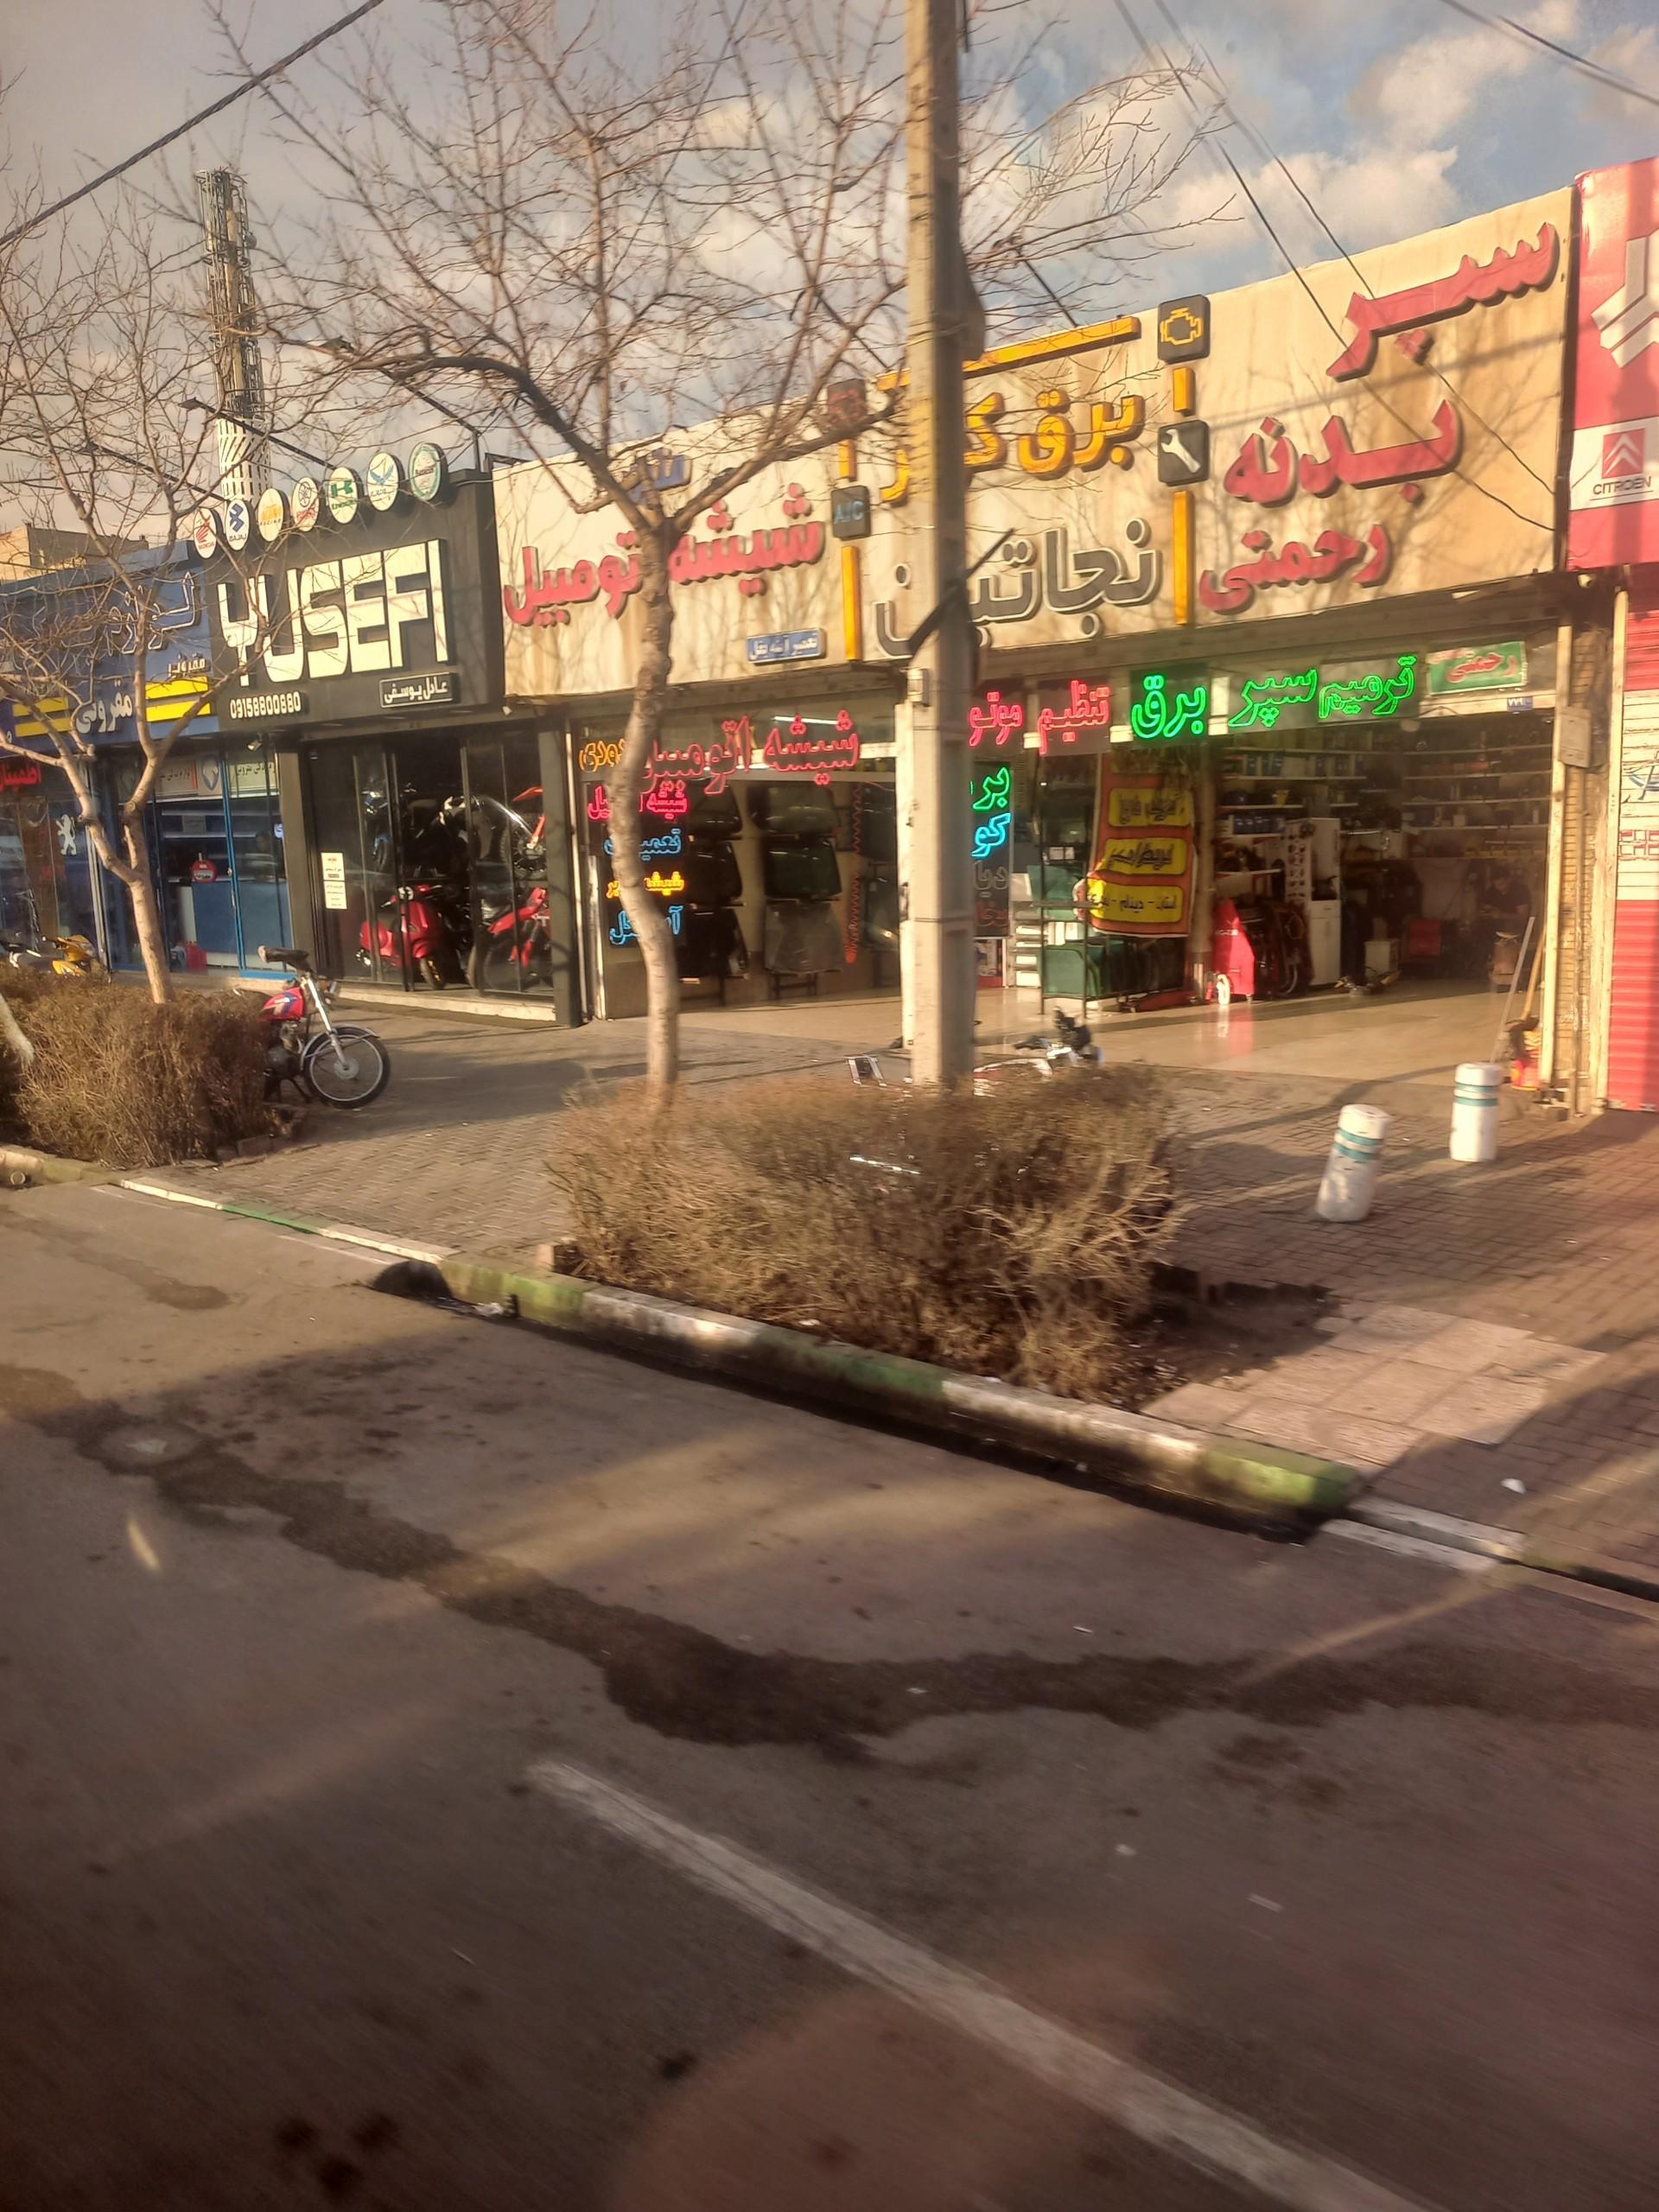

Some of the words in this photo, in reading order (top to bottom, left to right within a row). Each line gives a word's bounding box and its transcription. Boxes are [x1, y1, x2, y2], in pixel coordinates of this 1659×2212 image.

[1326, 221, 1558, 380] سپر
[880, 391, 1006, 503] کر
[1019, 389, 1144, 475] برق
[1224, 399, 1462, 506] بدنه
[503, 530, 645, 627] تومبیل
[668, 482, 826, 597] شیشه
[1198, 524, 1391, 613] رحمتی
[217, 538, 449, 687] YUSEFI
[873, 518, 1161, 659] نجاتین
[230, 690, 302, 720] 09158800880
[384, 683, 423, 704] یوسفی
[423, 676, 448, 701] عادل
[1037, 679, 1111, 755] تنظیم
[1131, 675, 1207, 739] برق
[1227, 668, 1318, 728] سپر
[1318, 655, 1418, 720] ترمیم
[763, 709, 859, 785] شیشه
